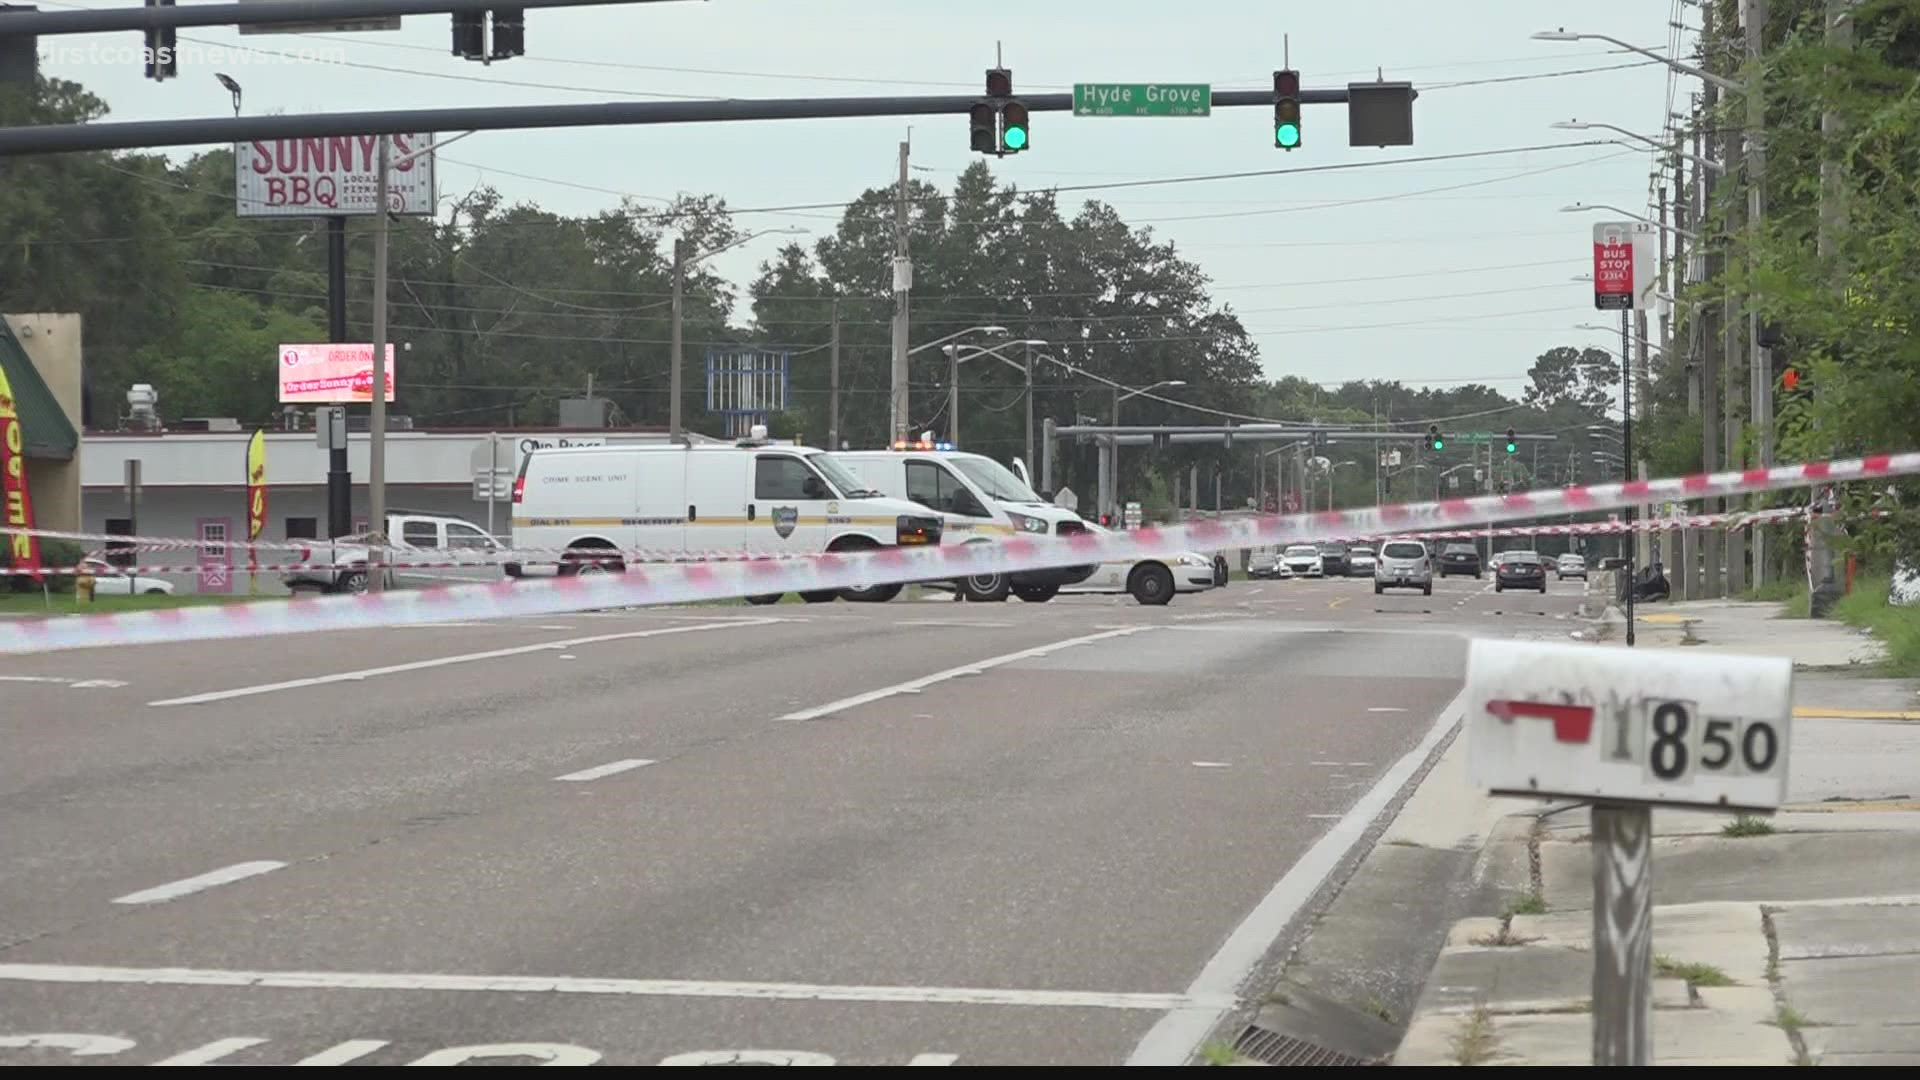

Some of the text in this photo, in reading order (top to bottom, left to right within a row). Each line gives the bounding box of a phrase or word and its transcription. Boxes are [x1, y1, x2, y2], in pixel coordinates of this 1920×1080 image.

[1083, 85, 1201, 106] Hyde Grove
[264, 175, 338, 208] BBQ
[1603, 250, 1626, 259] BUS
[1600, 260, 1630, 270] STOP
[329, 351, 357, 361] ORDER
[543, 473, 627, 484] CRIME SCENE UNIT
[1610, 700, 1779, 781] 1850
